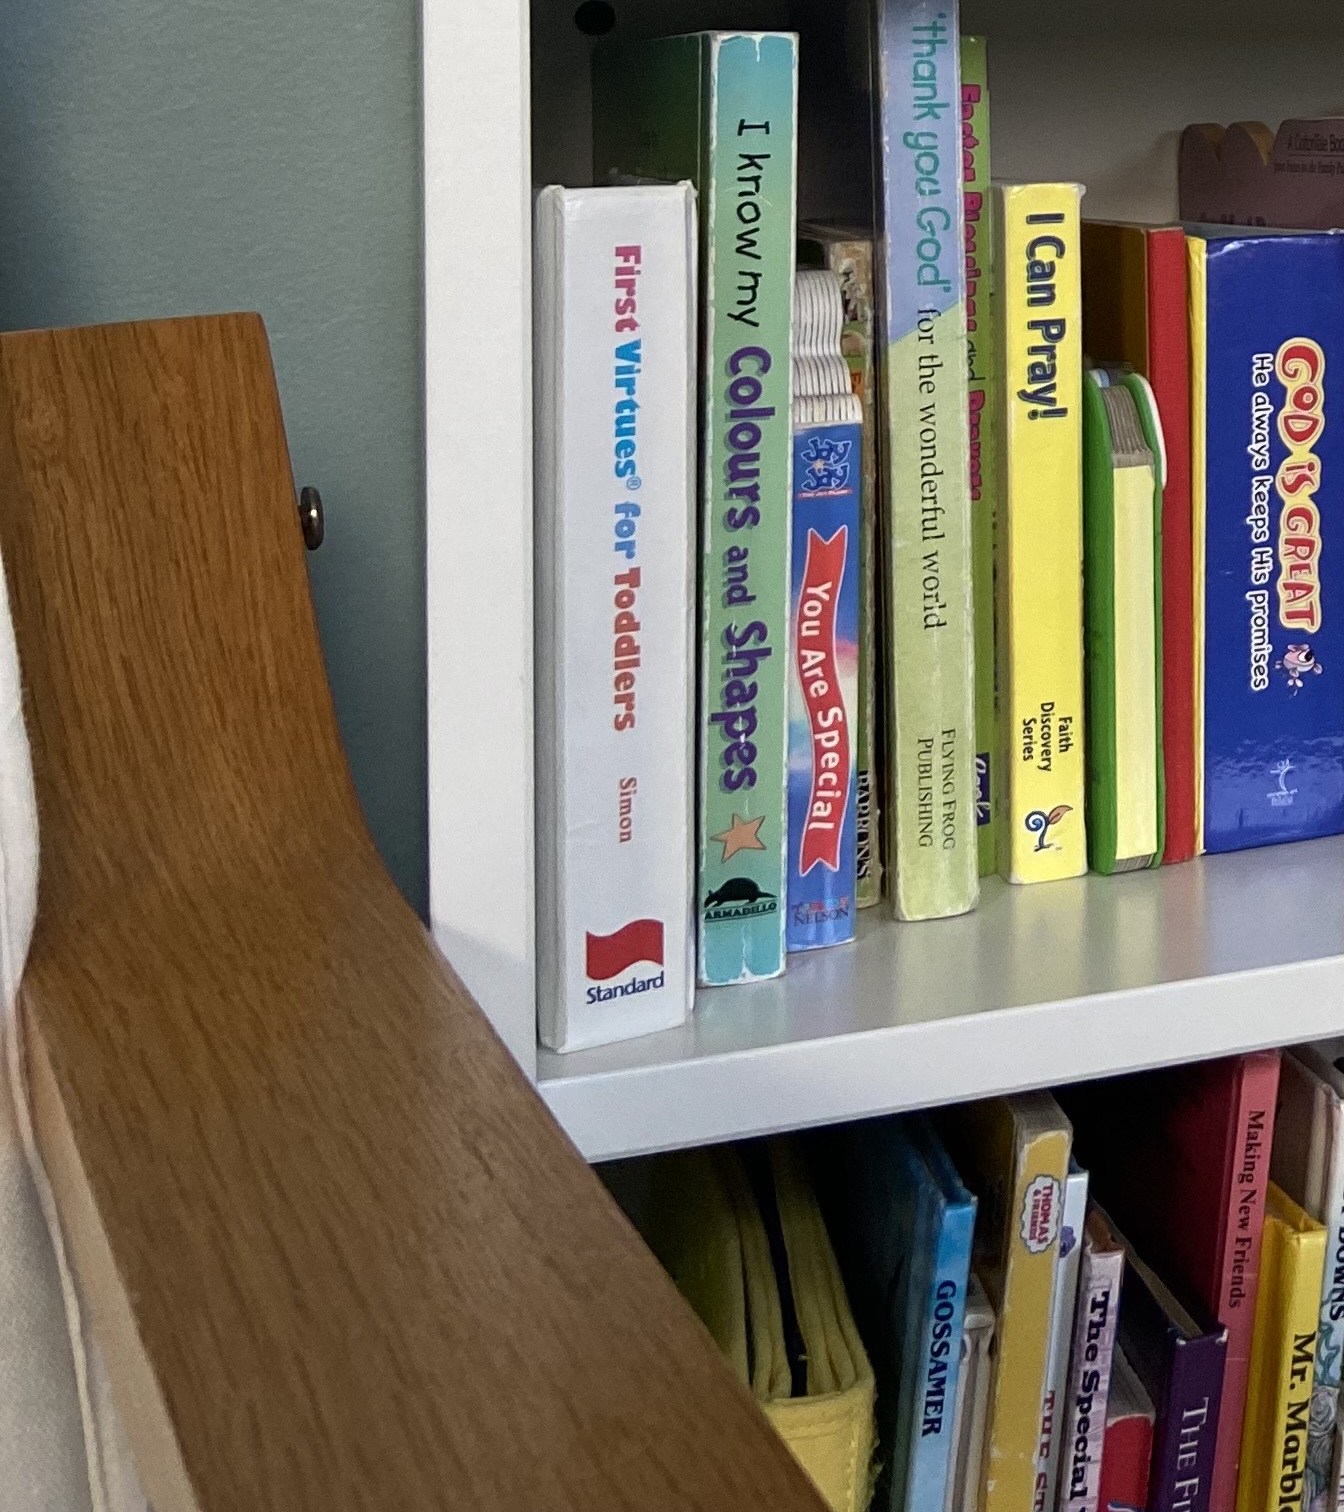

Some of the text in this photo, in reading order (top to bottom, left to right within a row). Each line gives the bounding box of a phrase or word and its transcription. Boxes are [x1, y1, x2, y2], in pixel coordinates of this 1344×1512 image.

[902, 131, 940, 196] you
[613, 243, 643, 334] First
[917, 306, 943, 346] for
[1017, 213, 1068, 421] I Can Pray!
[917, 352, 944, 395] the
[1280, 344, 1321, 445] GOD
[710, 118, 776, 792] I know my Colours and Shapes
[918, 403, 946, 541] wonderful
[613, 501, 642, 561] for
[1247, 354, 1273, 690] He always keeps His promises
[921, 550, 948, 630] world
[1281, 505, 1320, 629] GREAT
[613, 566, 642, 734] Toddlers
[800, 580, 845, 833] You Are Special
[1021, 718, 1038, 762] Series
[1039, 701, 1056, 772] Discovery
[1058, 715, 1073, 754] Faith
[618, 777, 640, 845] Simon
[917, 738, 934, 849] PUBLISHING
[941, 728, 957, 850] FLYING FROG
[704, 900, 778, 921] ARMADILLO
[585, 969, 666, 1006] Standard
[1037, 1182, 1054, 1245] THOMAS
[1228, 1109, 1266, 1310] Making New Friends
[921, 1279, 958, 1438] GOSSAMER
[1069, 1290, 1111, 1510] The Special
[1287, 1332, 1318, 1392] Mr.
[1176, 1395, 1211, 1470] THE
